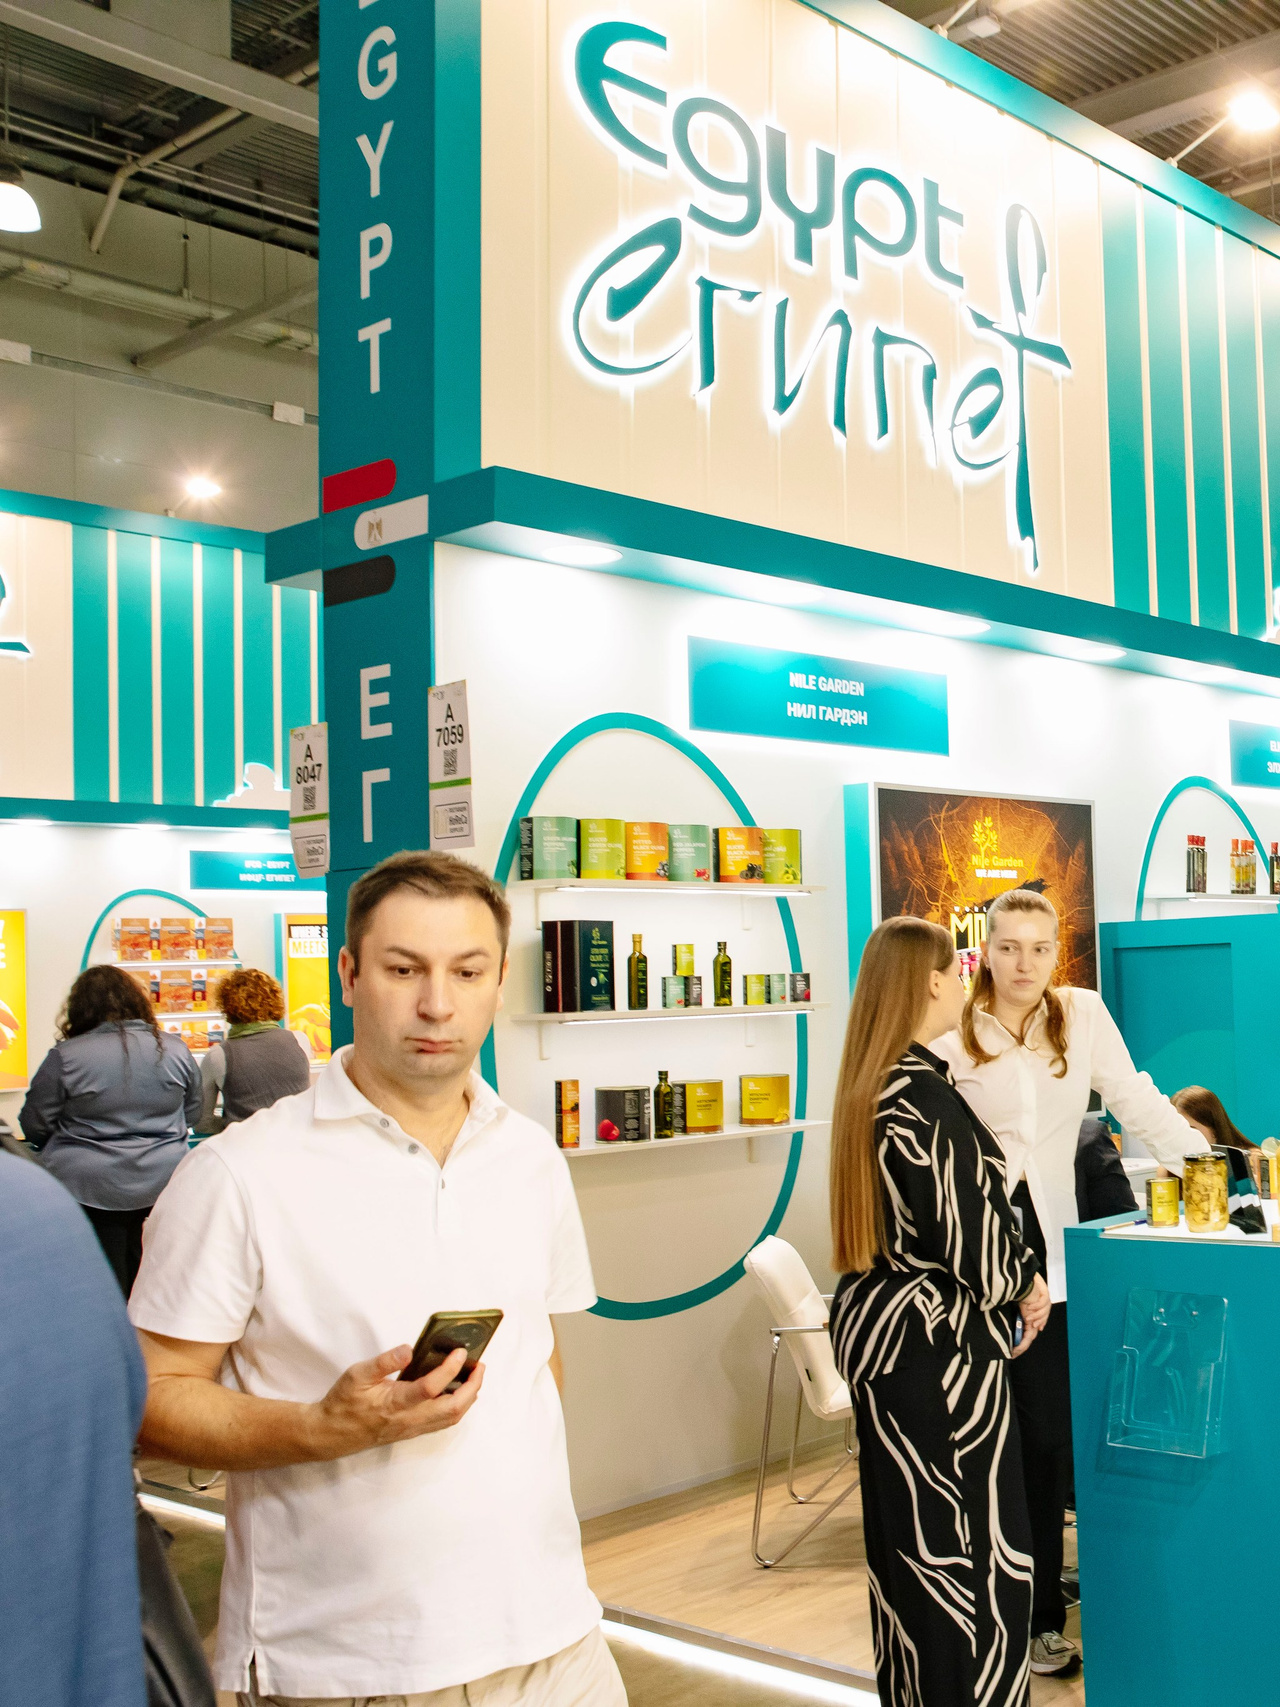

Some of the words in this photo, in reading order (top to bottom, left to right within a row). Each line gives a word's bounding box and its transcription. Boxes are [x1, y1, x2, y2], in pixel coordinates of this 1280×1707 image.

[574, 21, 965, 289] Egypt
[356, 0, 397, 394] GYPT
[789, 671, 817, 690] NILE
[818, 676, 865, 697] GARDEN
[445, 703, 454, 723] A
[786, 701, 816, 719] НИЛ
[818, 705, 868, 727] ГАРДЭН
[435, 724, 464, 747] 7059
[304, 744, 314, 762] A
[296, 763, 322, 784] 8047
[971, 854, 990, 868] Nile
[992, 855, 1024, 868] Garden
[292, 941, 327, 954] MEETS
